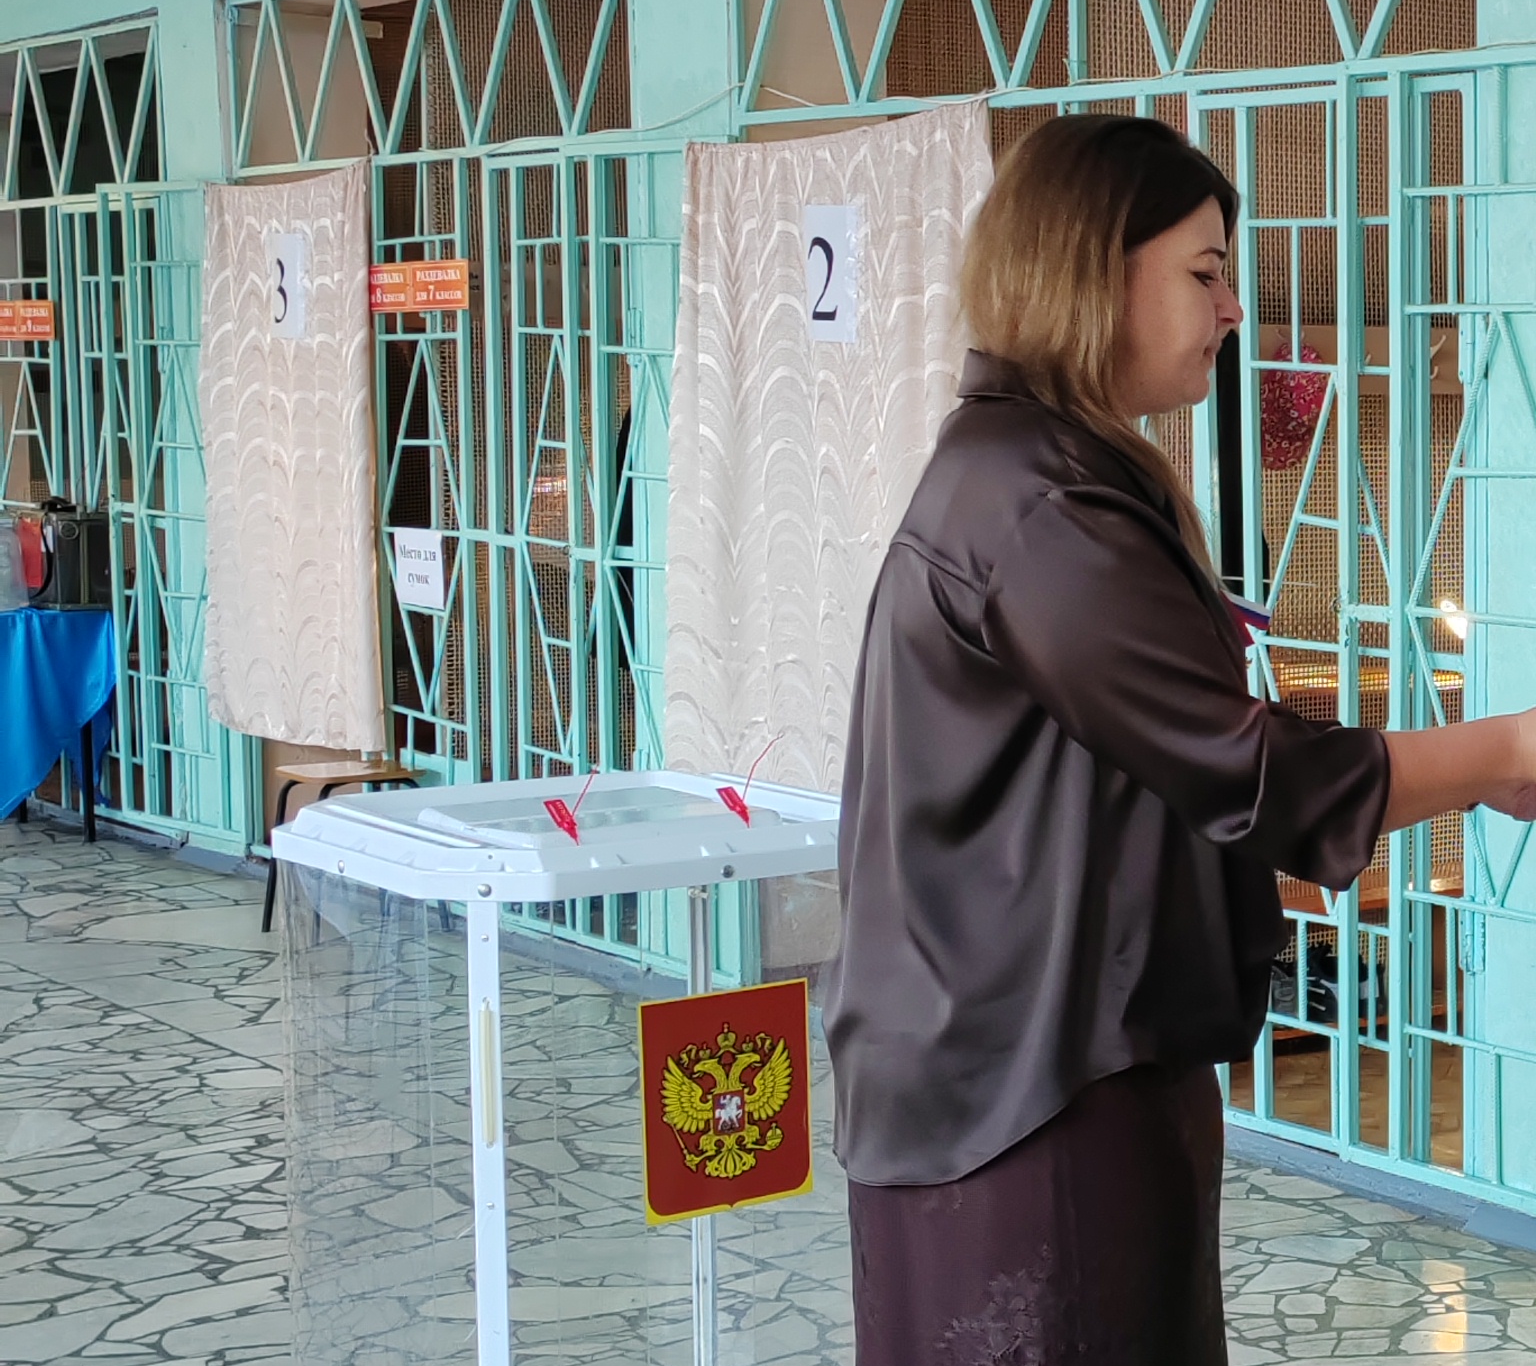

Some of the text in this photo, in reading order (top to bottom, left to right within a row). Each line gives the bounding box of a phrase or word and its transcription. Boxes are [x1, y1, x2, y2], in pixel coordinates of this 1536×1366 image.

[274, 257, 287, 324] 3
[376, 287, 383, 303] 8
[428, 285, 435, 301] 7
[808, 236, 838, 321] 2
